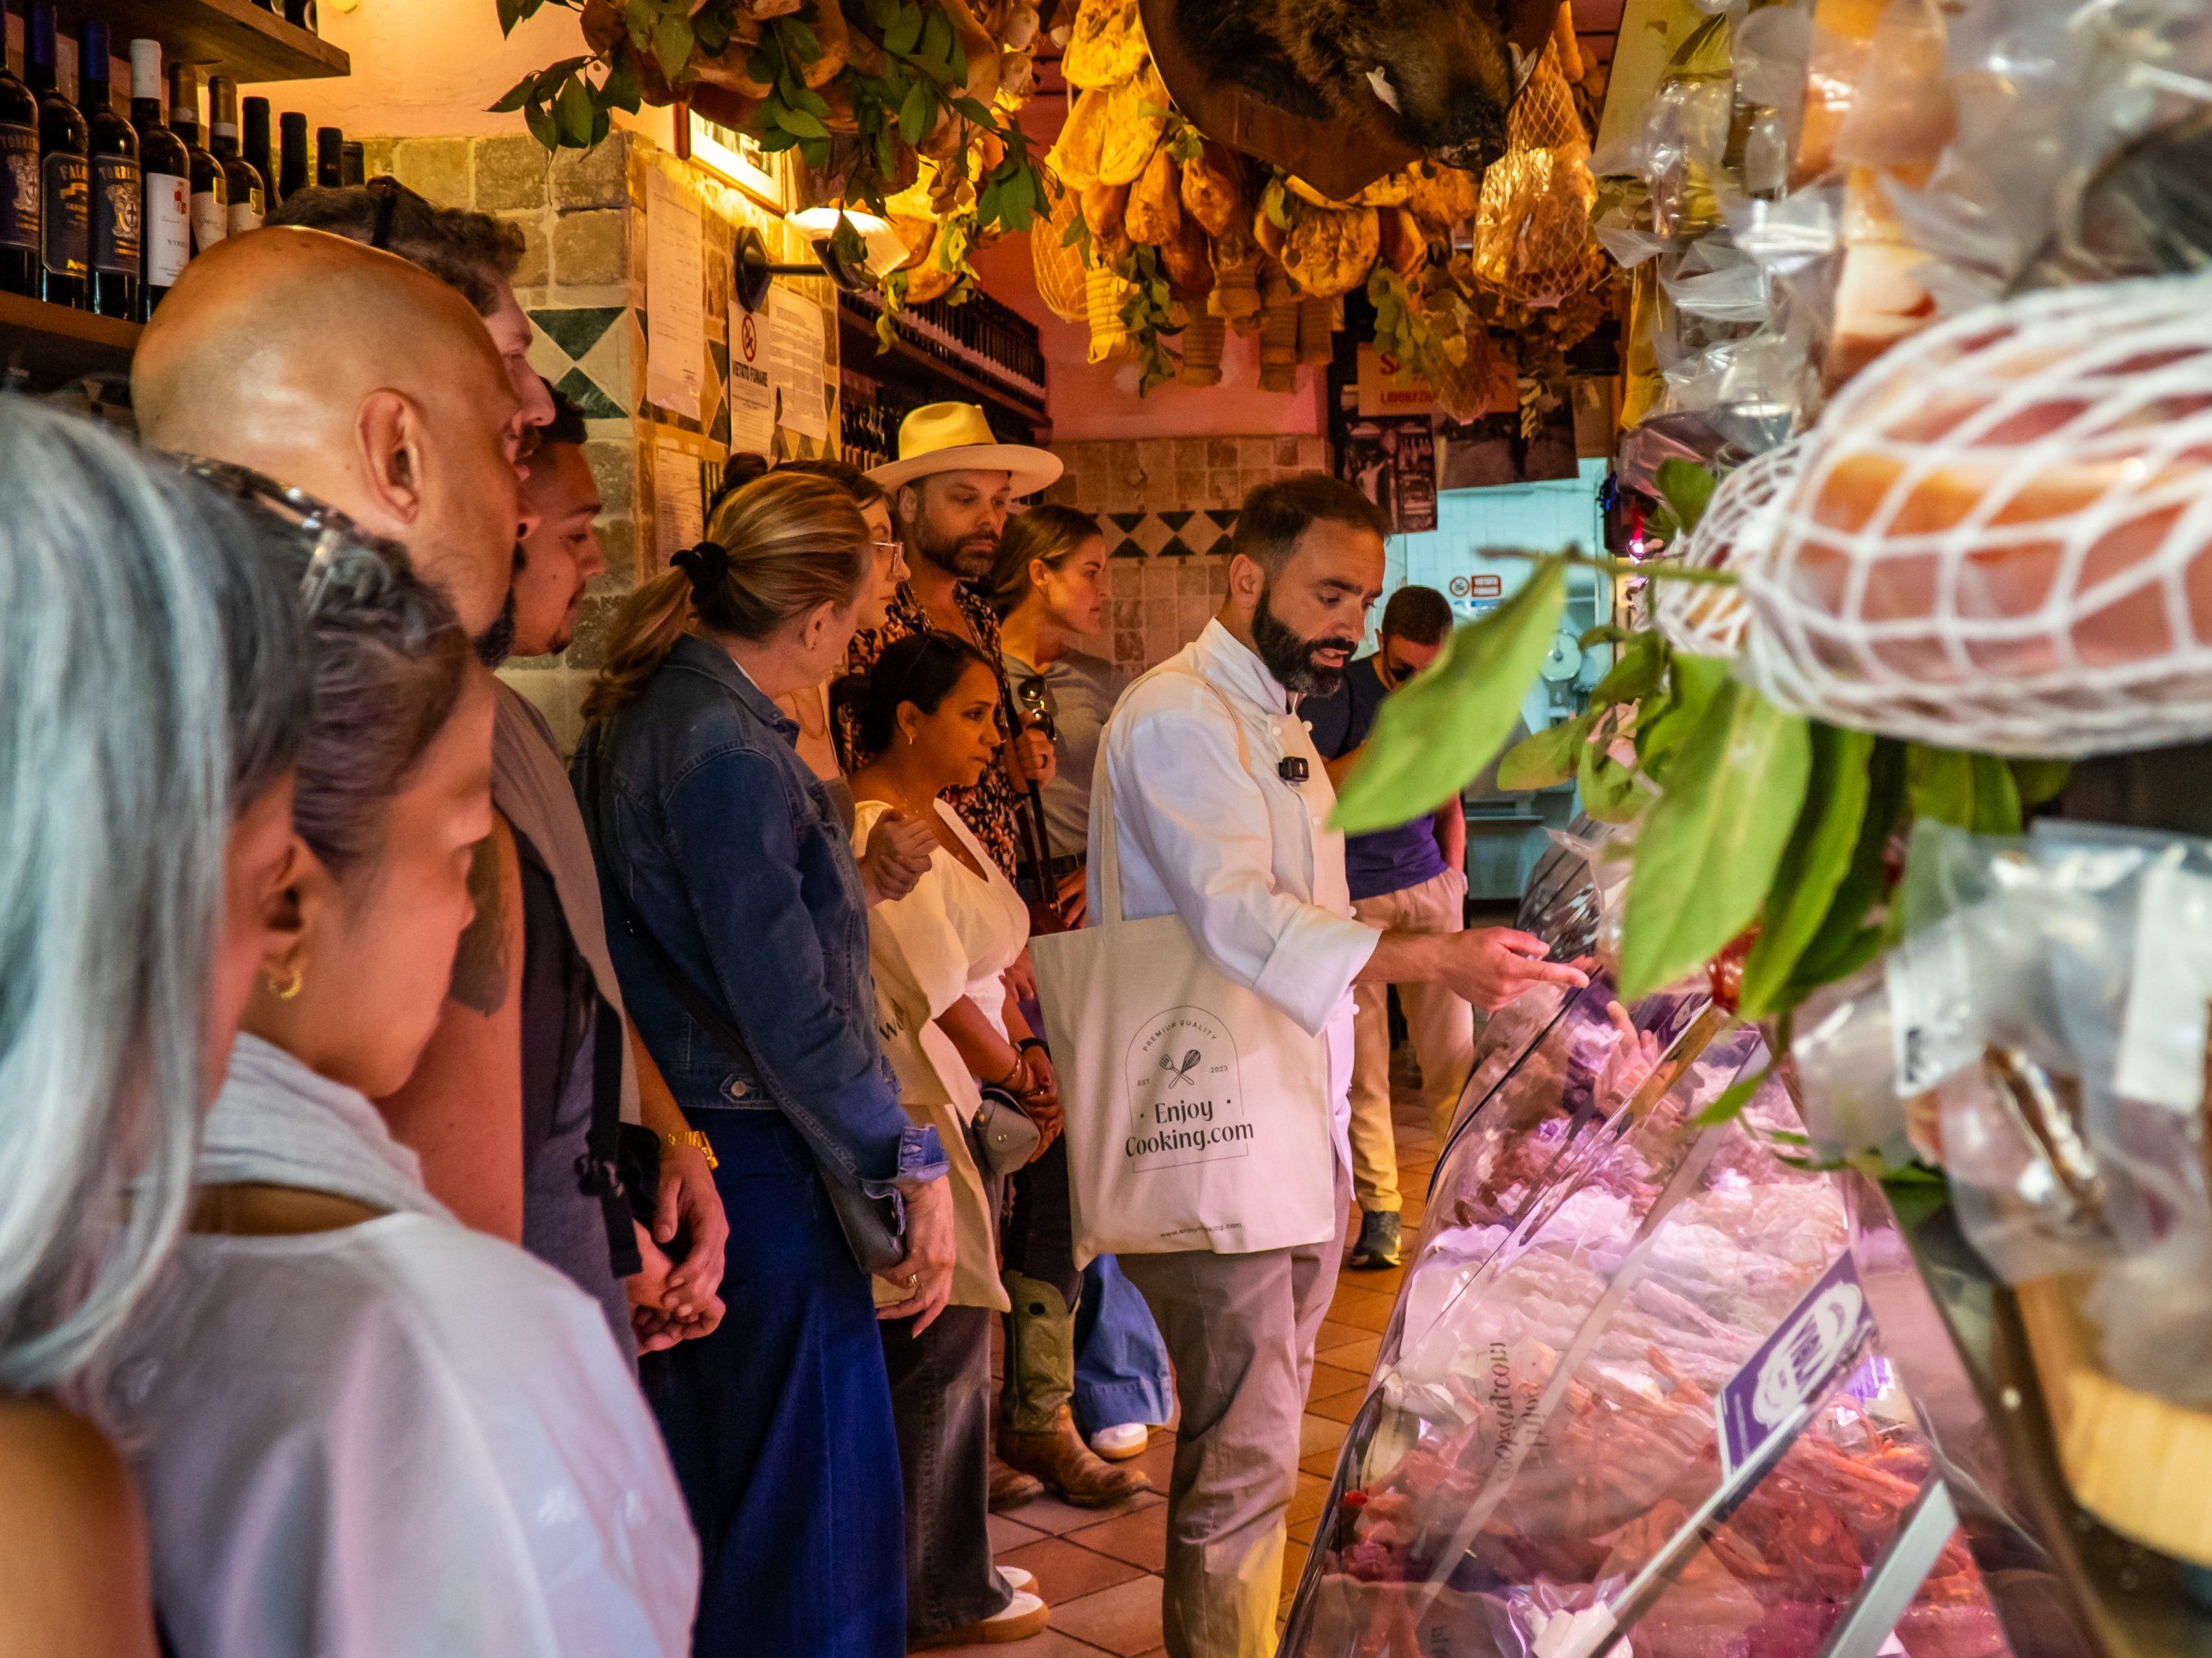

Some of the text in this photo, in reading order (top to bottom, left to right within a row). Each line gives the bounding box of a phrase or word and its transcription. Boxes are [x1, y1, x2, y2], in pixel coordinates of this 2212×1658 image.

[1142, 1019, 1217, 1051] PREMIUM QUALITY
[1137, 1065, 1229, 1087] EST 2023
[1154, 1099, 1214, 1125] Enjoy
[1125, 1123, 1254, 1158] Cooking.com
